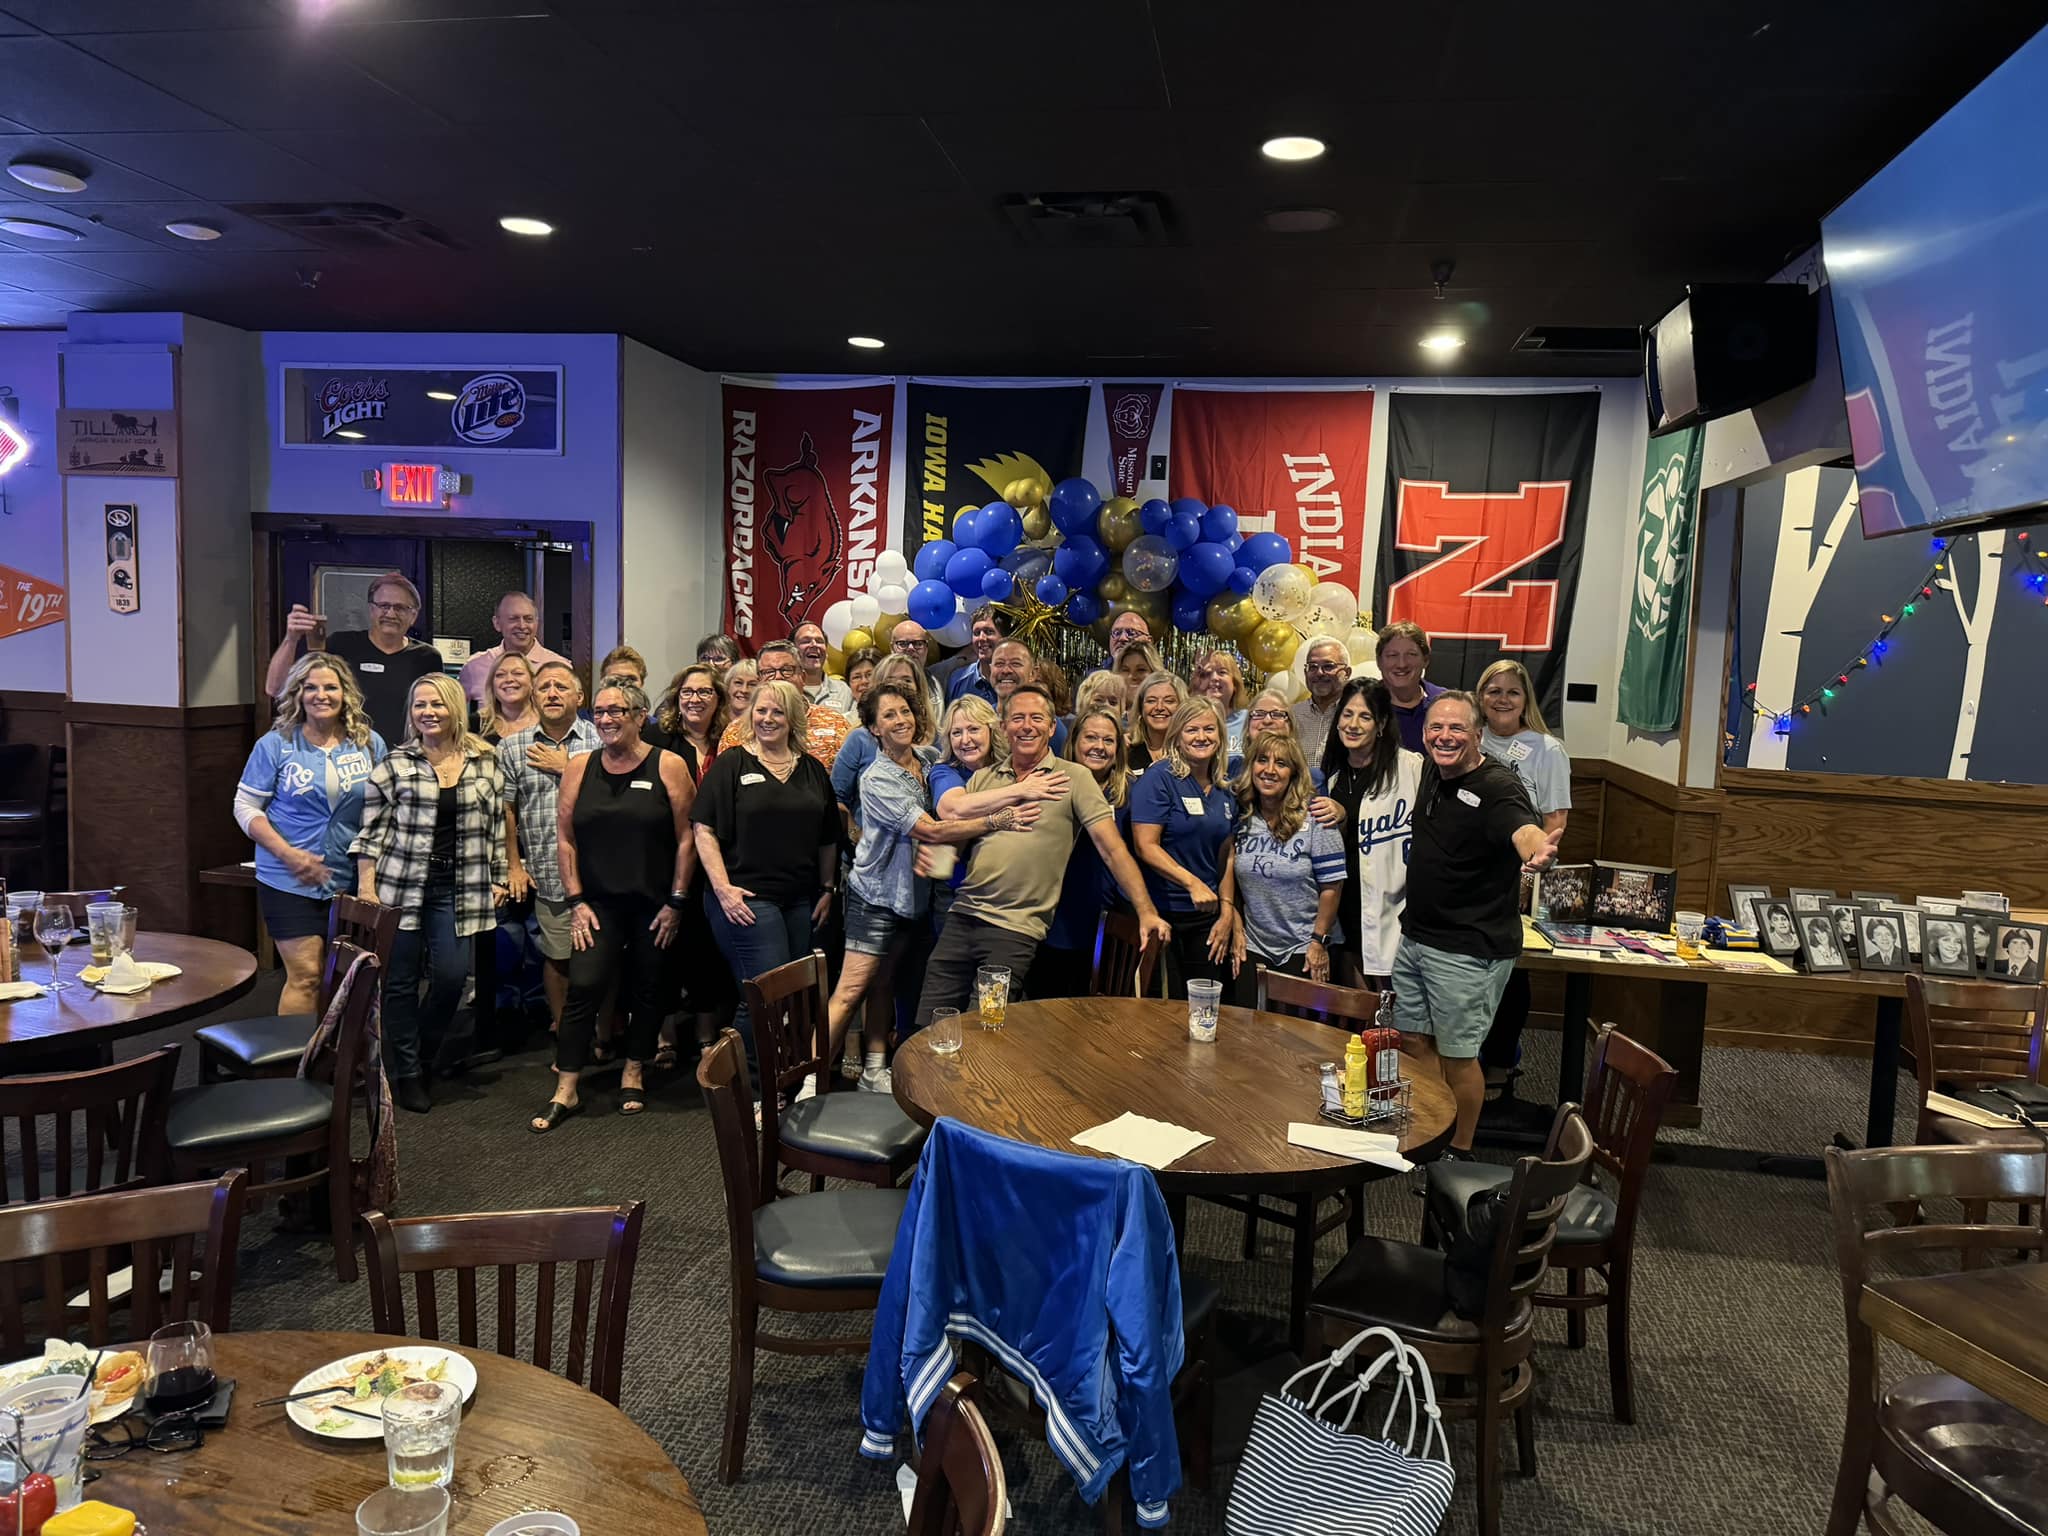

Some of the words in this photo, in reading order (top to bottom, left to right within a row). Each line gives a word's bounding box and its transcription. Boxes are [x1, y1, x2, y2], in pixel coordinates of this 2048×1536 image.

[315, 376, 389, 413] Coors
[460, 388, 520, 434] Lite
[322, 401, 386, 437] LIGHT
[923, 412, 948, 492] IOWA
[1118, 456, 1128, 483] State
[1126, 447, 1138, 493] Missouri
[391, 464, 436, 502] EXIT
[847, 408, 882, 600] ARKANS
[731, 409, 756, 639] RAZORBACKS
[922, 499, 944, 545] HA
[1282, 453, 1344, 577] INDIA
[1387, 478, 1571, 652] N
[17, 581, 33, 592] THE
[18, 594, 63, 622] 19TH
[1235, 833, 1305, 862] ROYALS
[1251, 855, 1273, 879] KC
